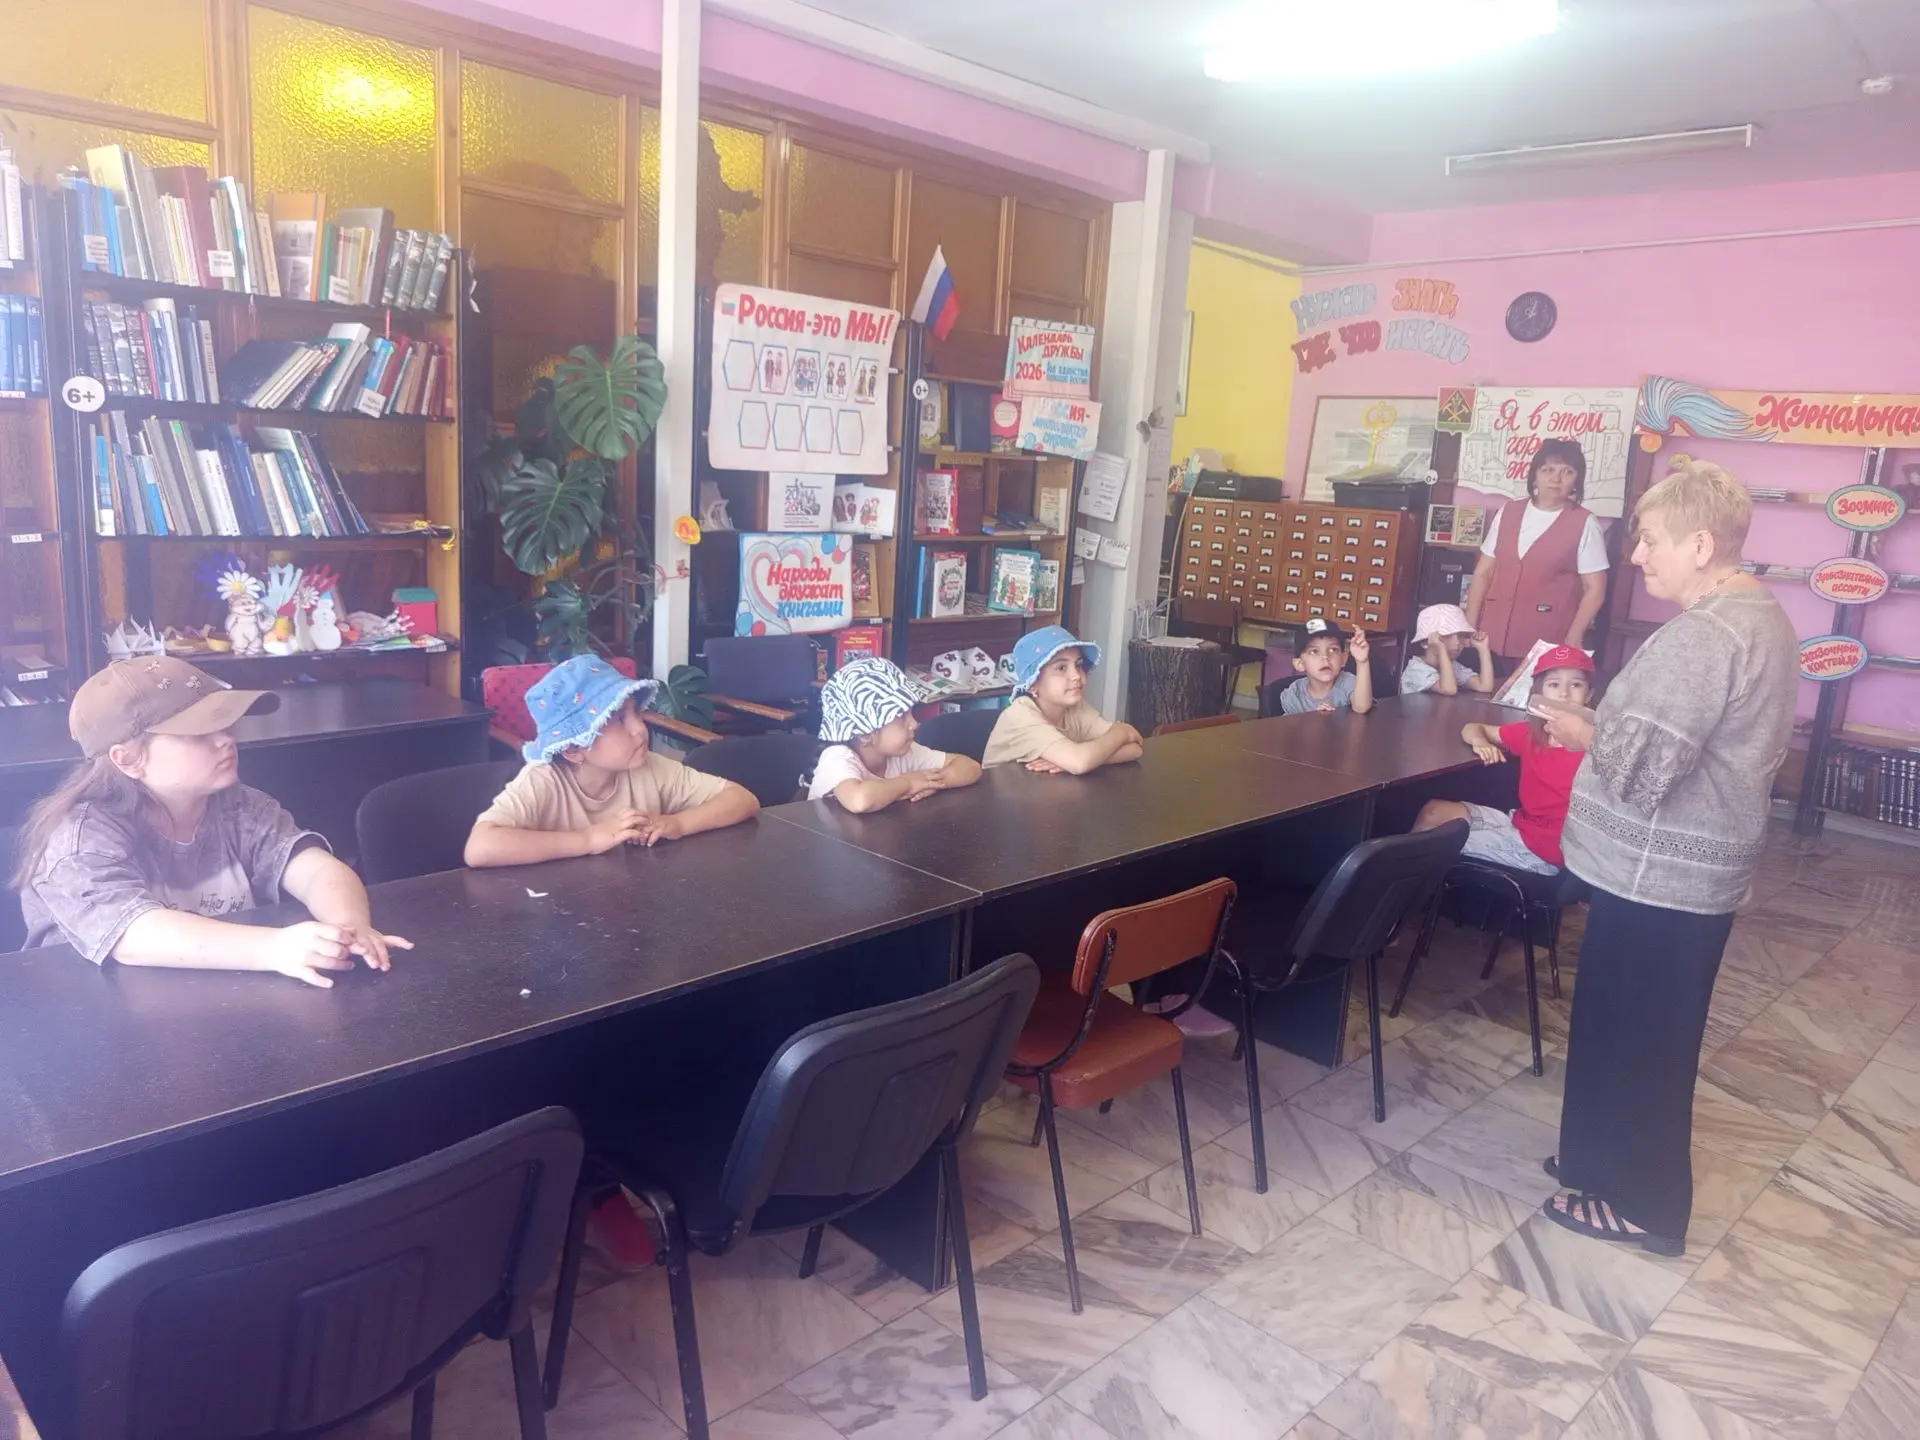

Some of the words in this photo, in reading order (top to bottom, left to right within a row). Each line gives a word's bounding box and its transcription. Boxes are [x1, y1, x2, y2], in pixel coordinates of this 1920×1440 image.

[67, 388, 95, 404] 6+
[1494, 398, 1520, 431] Я
[767, 556, 832, 586] Народы
